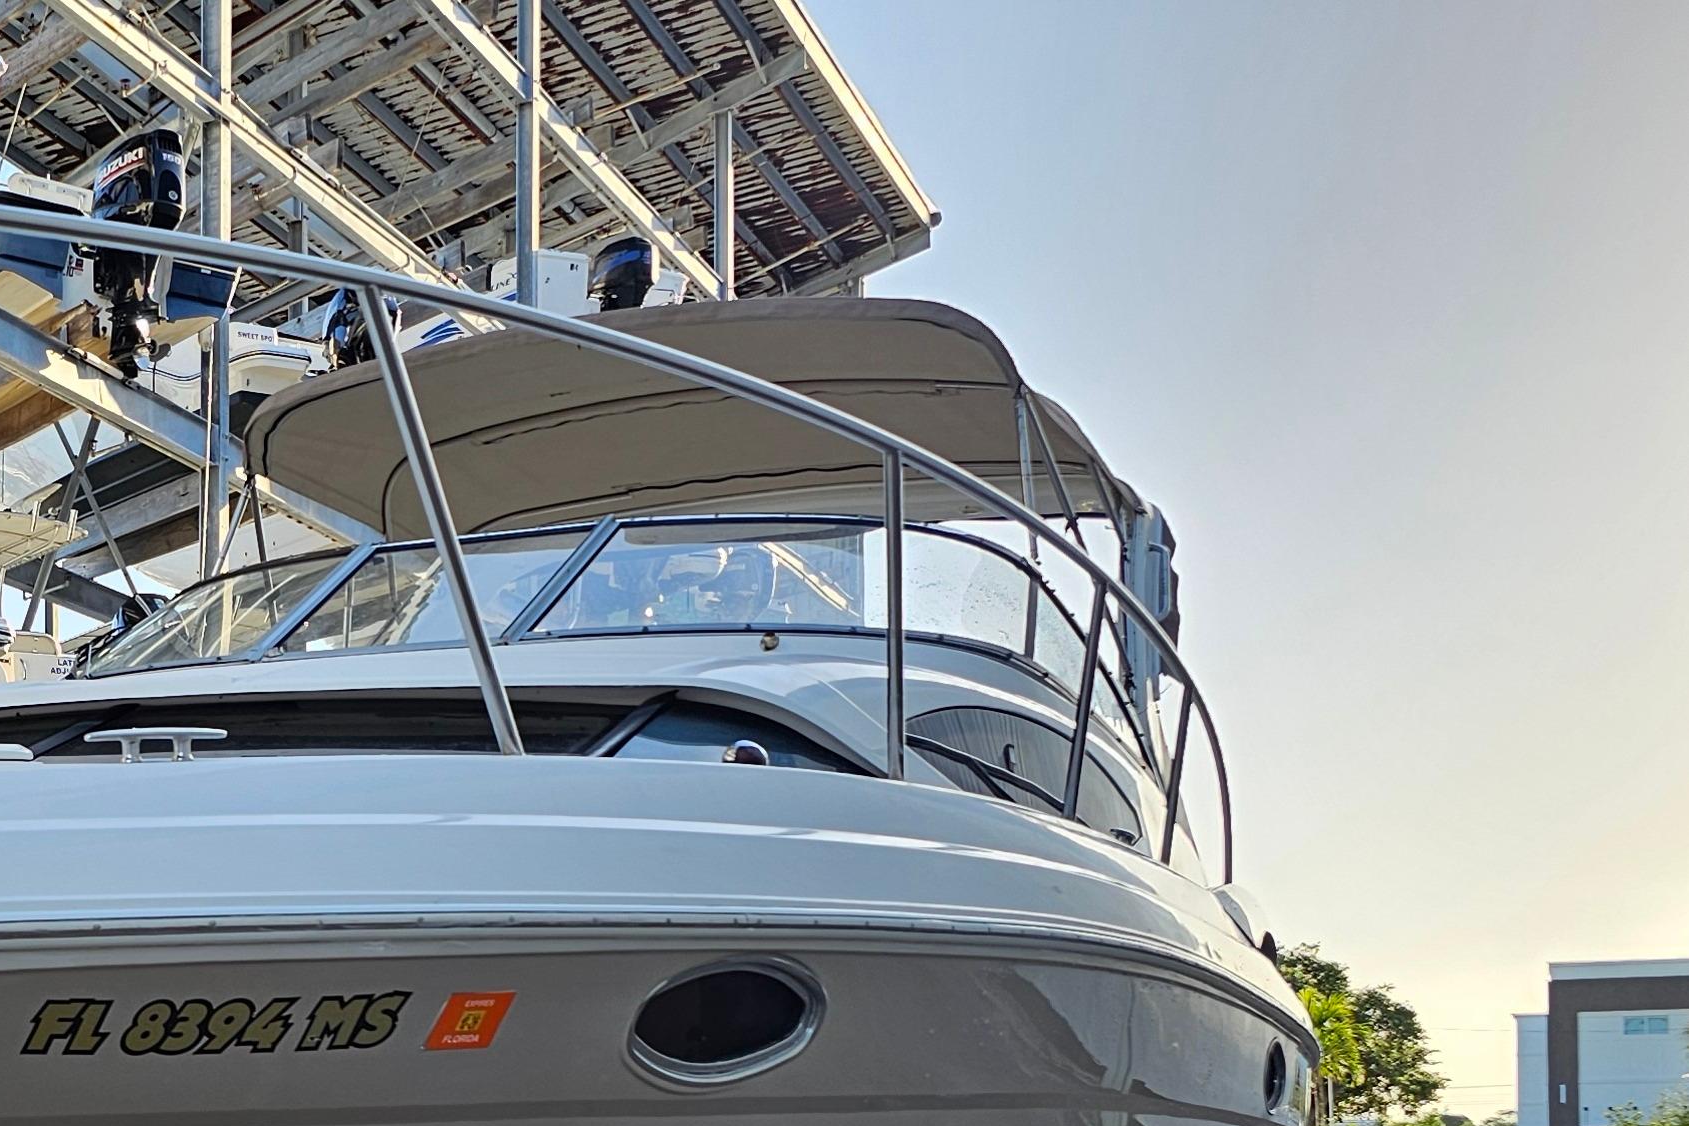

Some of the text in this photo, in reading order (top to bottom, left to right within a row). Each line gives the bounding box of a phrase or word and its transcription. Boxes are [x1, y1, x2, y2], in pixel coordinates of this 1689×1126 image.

[20, 991, 413, 1056] FL 8394 MS
